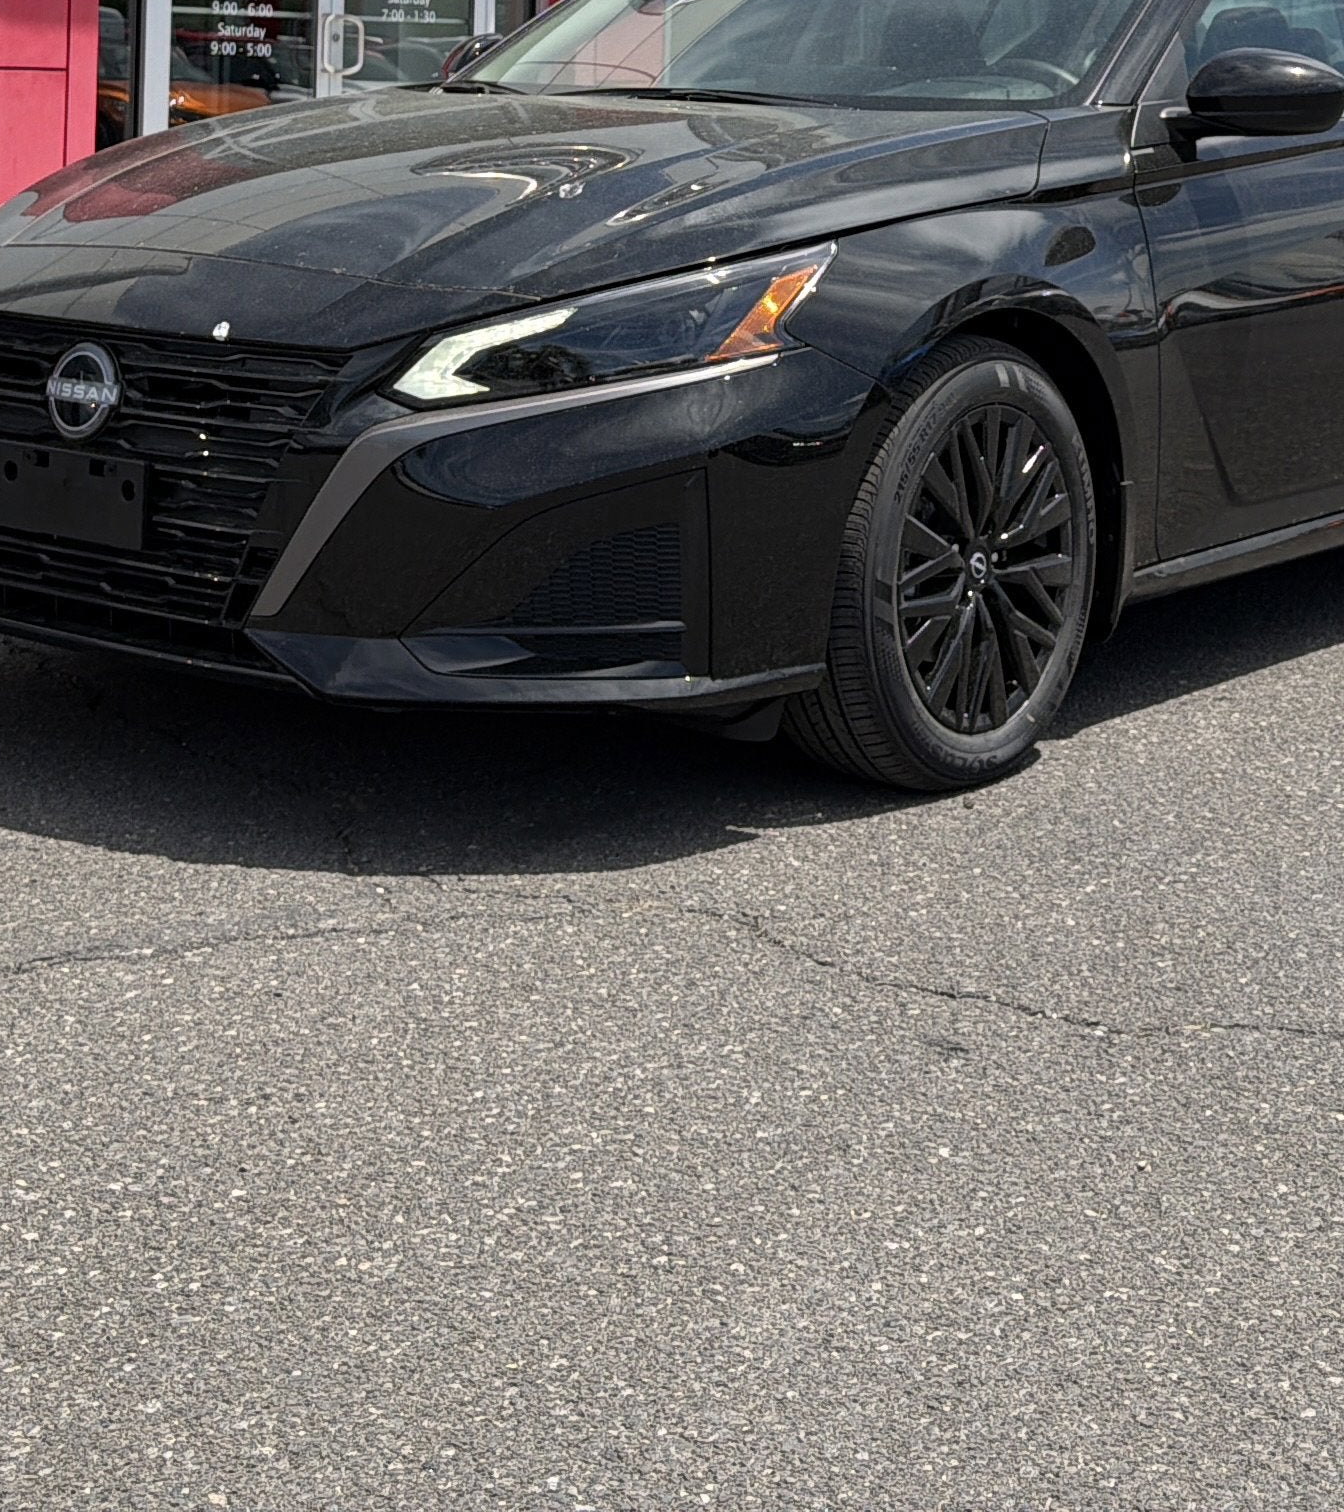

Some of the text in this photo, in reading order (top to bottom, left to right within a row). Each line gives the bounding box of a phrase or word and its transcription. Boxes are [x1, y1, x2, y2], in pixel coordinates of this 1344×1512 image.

[212, 0, 238, 16] 9:00
[247, 2, 274, 18] 6:00
[381, 8, 405, 23] 7:00
[217, 21, 267, 41] Saturday
[210, 40, 237, 56] 9:00
[246, 42, 272, 58] 5:00
[46, 378, 118, 404] NISSAN
